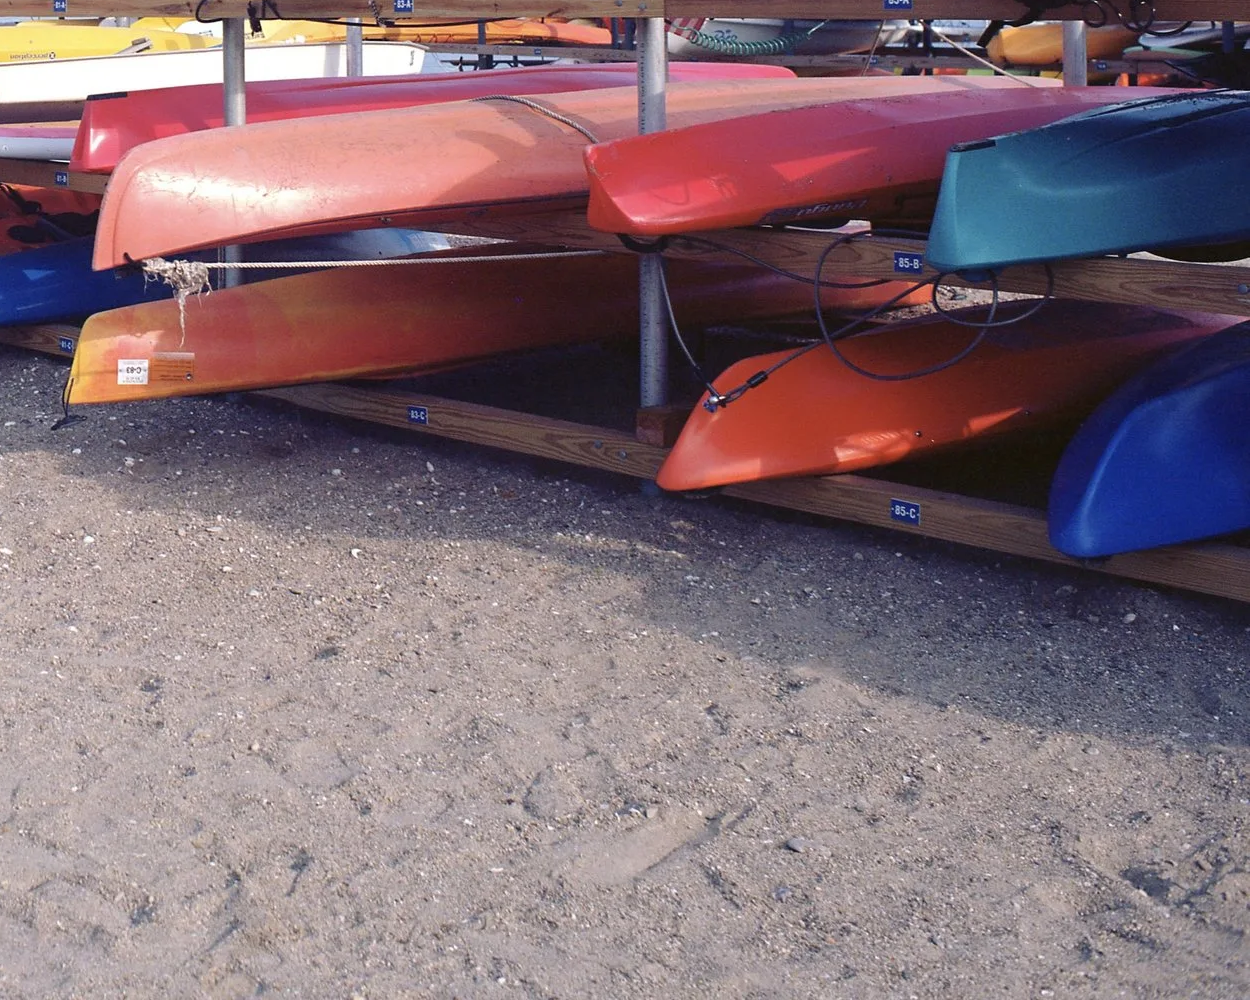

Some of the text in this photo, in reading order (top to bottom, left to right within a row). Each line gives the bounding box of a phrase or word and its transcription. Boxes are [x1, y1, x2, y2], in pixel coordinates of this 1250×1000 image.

[898, 257, 920, 269] 85-B
[126, 366, 142, 375] C-83
[894, 504, 916, 519] 85-C
